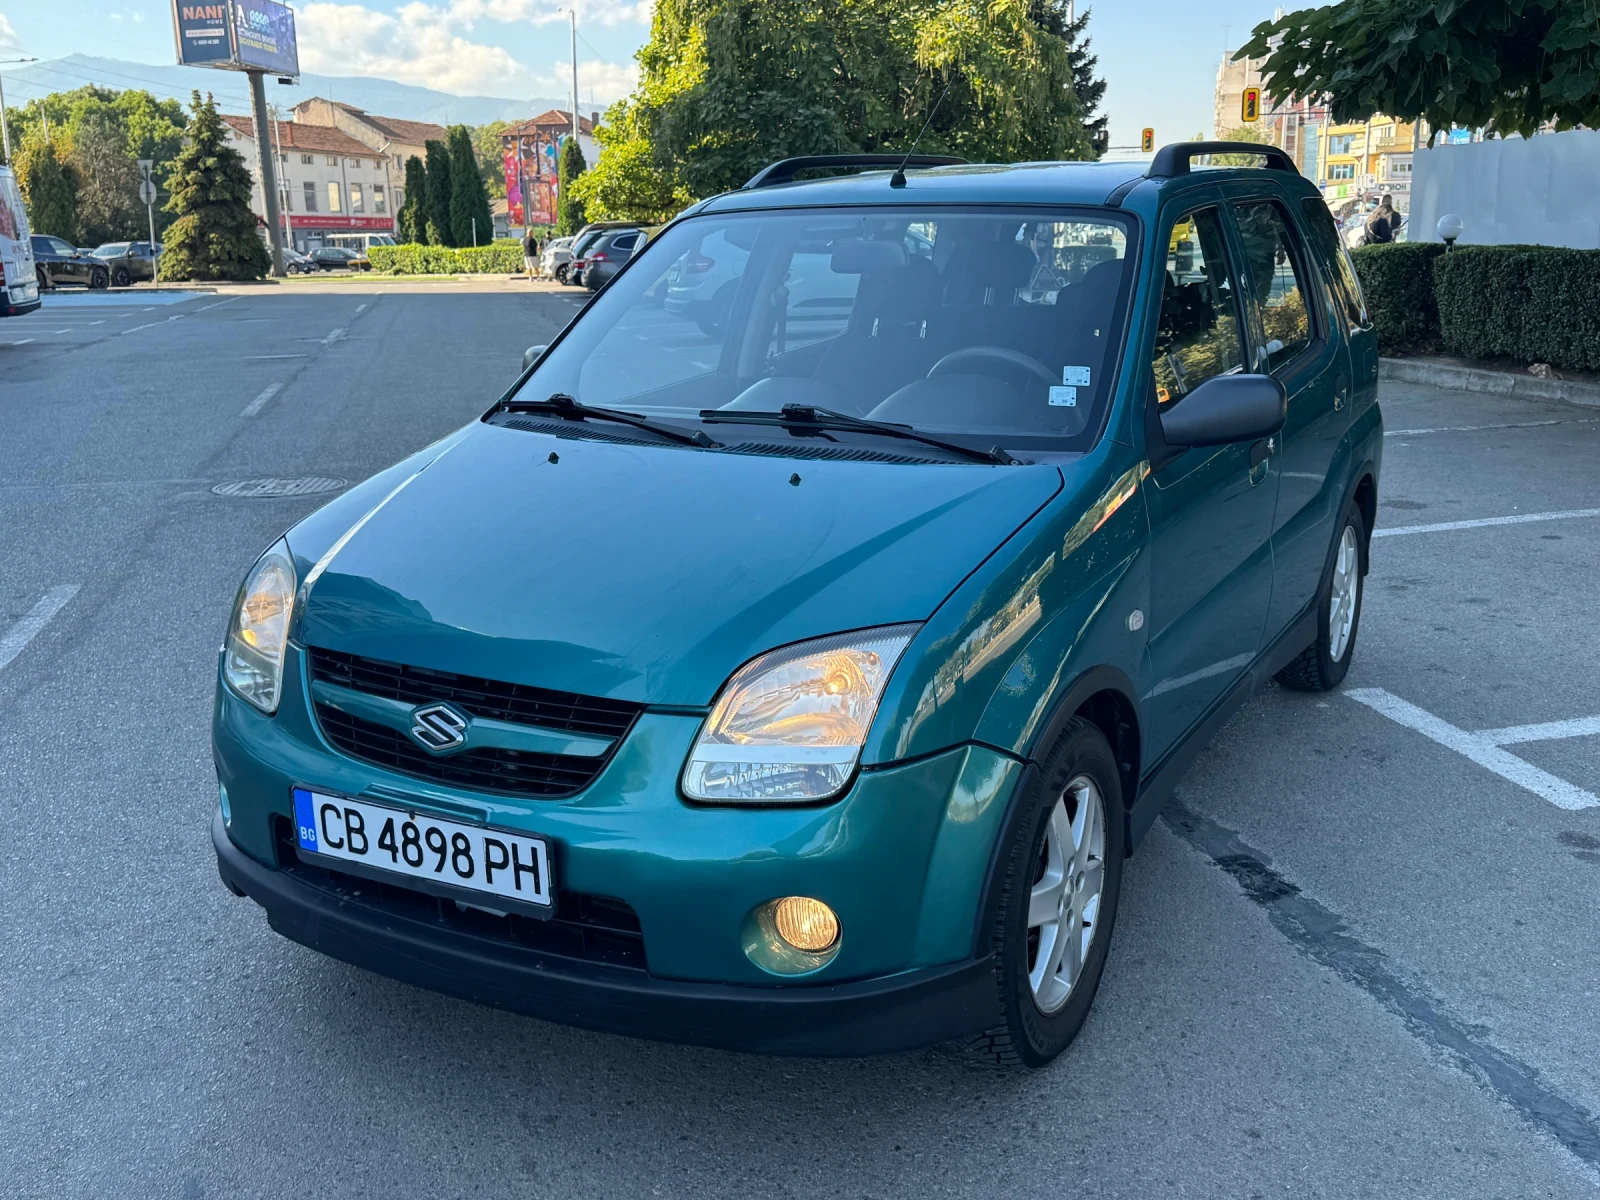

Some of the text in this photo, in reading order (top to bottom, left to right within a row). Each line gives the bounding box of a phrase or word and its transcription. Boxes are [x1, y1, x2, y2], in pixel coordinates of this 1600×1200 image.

[183, 6, 223, 20] NANI
[300, 826, 316, 842] BG
[378, 817, 475, 879] 4898
